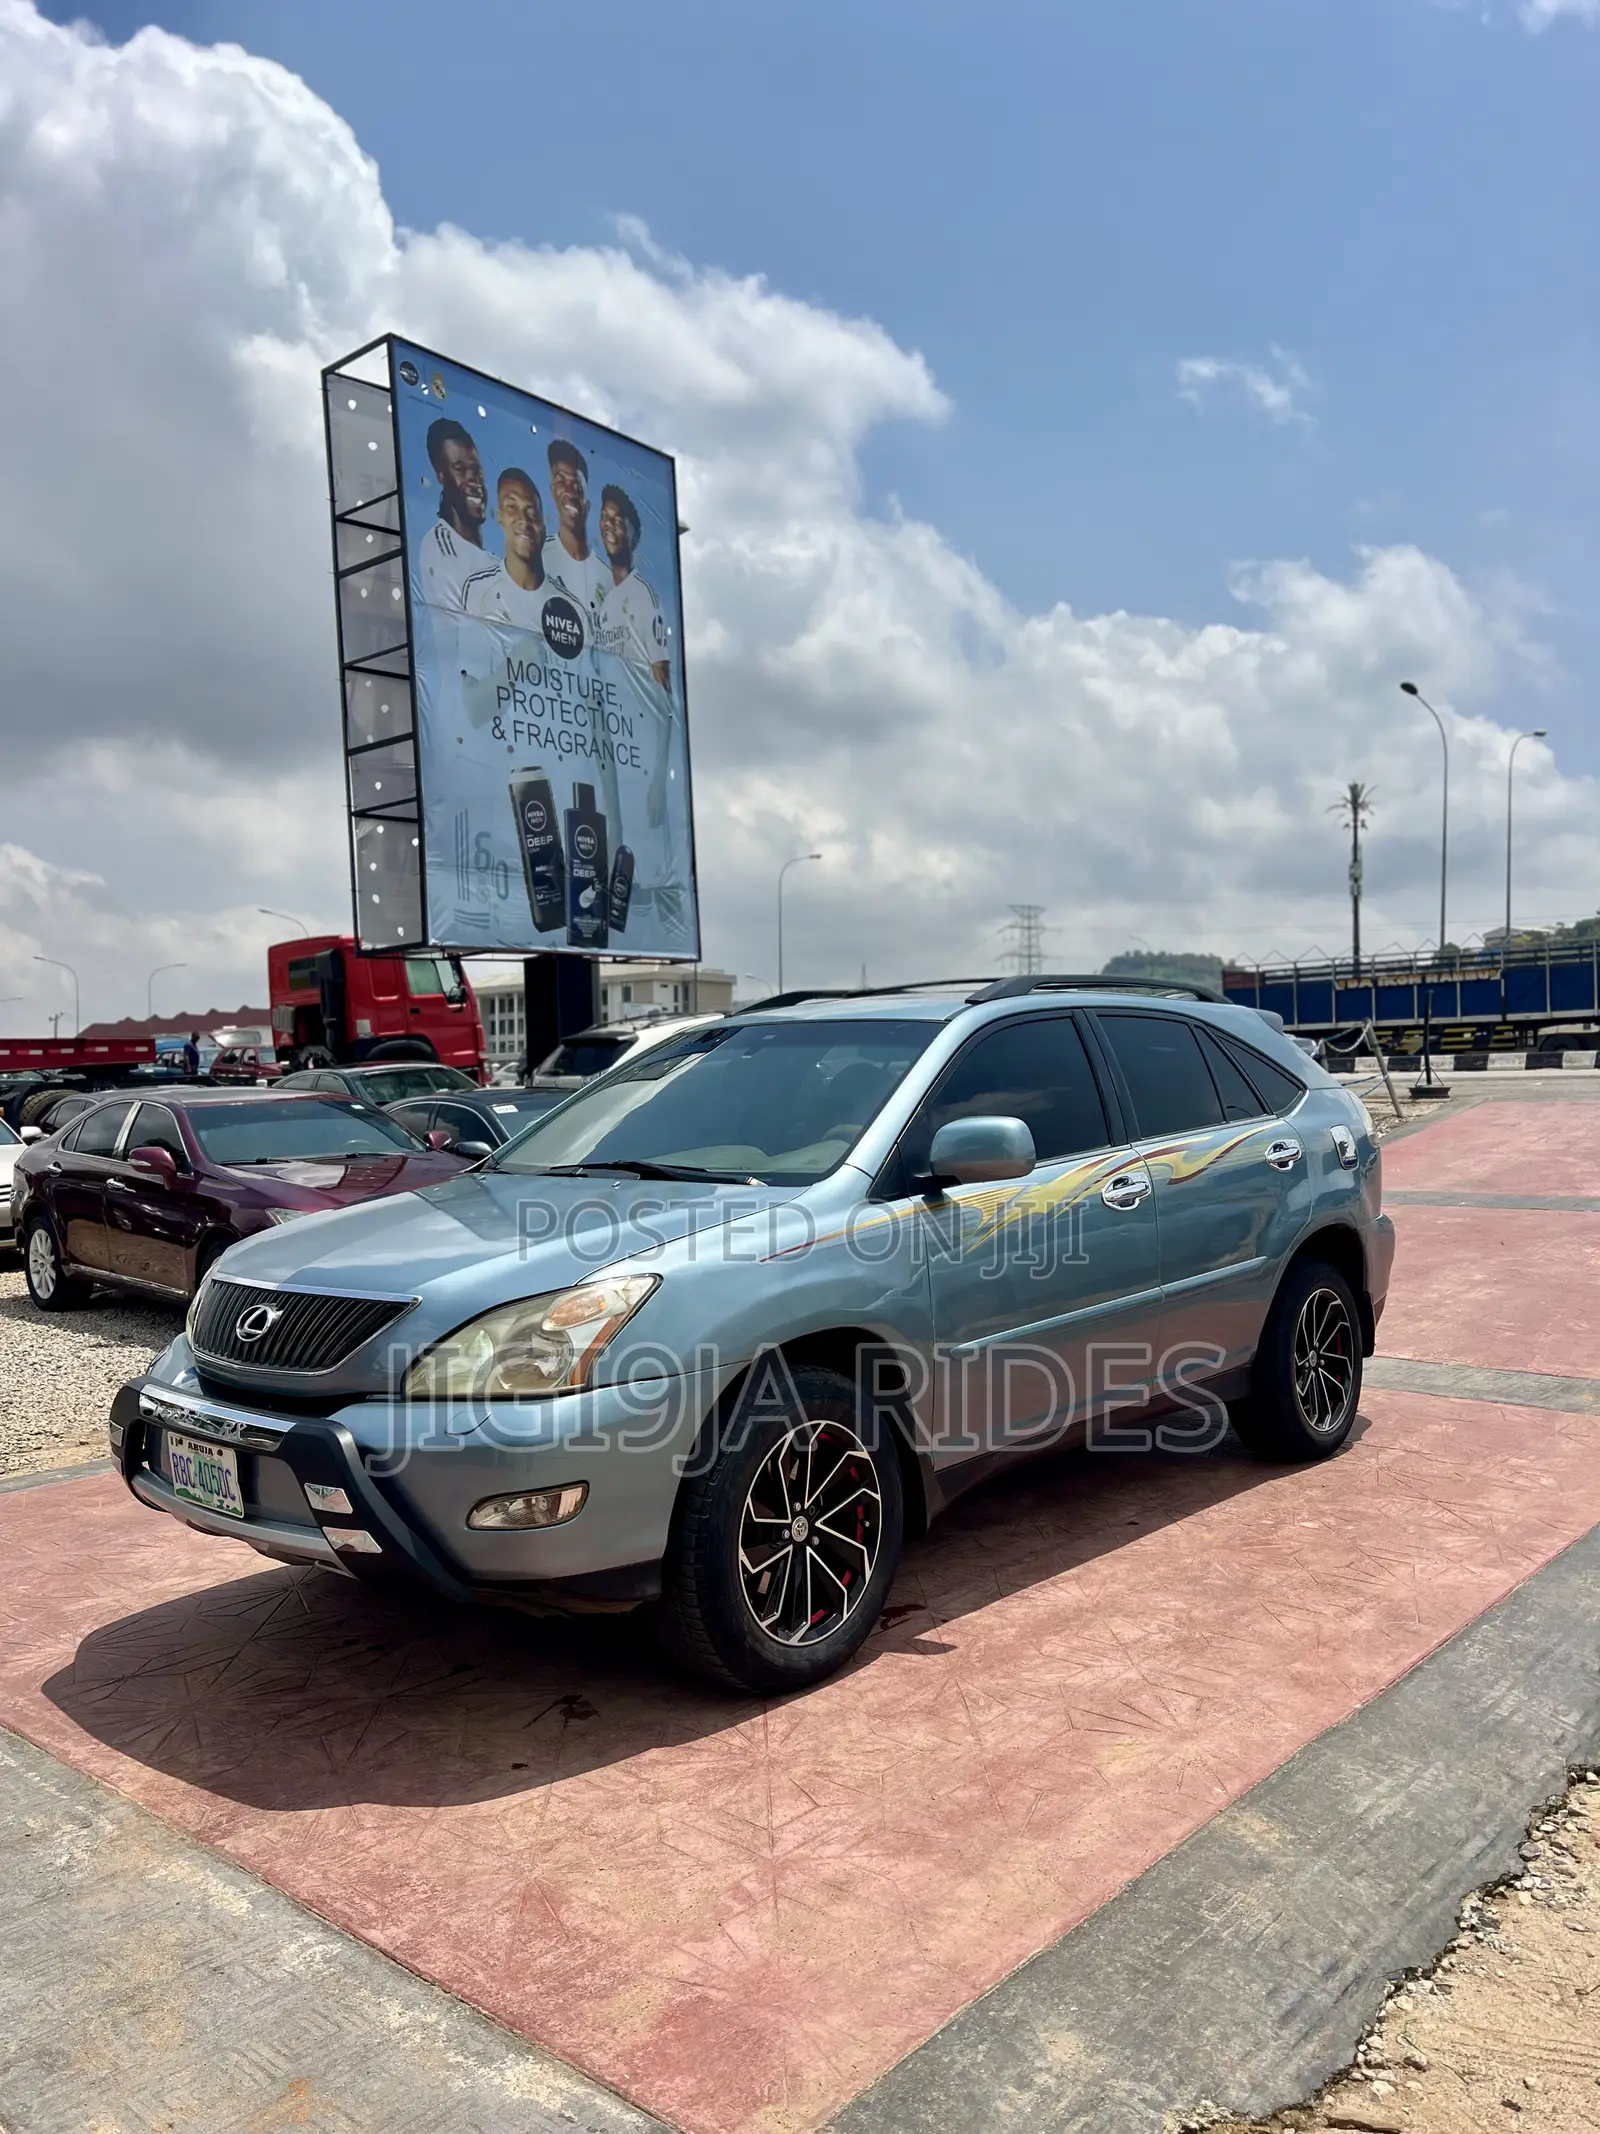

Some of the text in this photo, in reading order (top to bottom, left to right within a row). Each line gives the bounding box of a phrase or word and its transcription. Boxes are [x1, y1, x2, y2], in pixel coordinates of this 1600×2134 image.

[546, 614, 581, 635] NIVEA
[551, 630, 577, 647] MEN
[506, 656, 623, 711] MOISTURE,
[496, 685, 634, 739] PROTECTION
[491, 715, 641, 769] & FRAGRANCE
[527, 810, 544, 819] NIVEA
[526, 835, 554, 848] DEEP
[577, 836, 595, 845] NIVEA
[573, 868, 596, 878] DEEP
[187, 1441, 214, 1457] ABUJA
